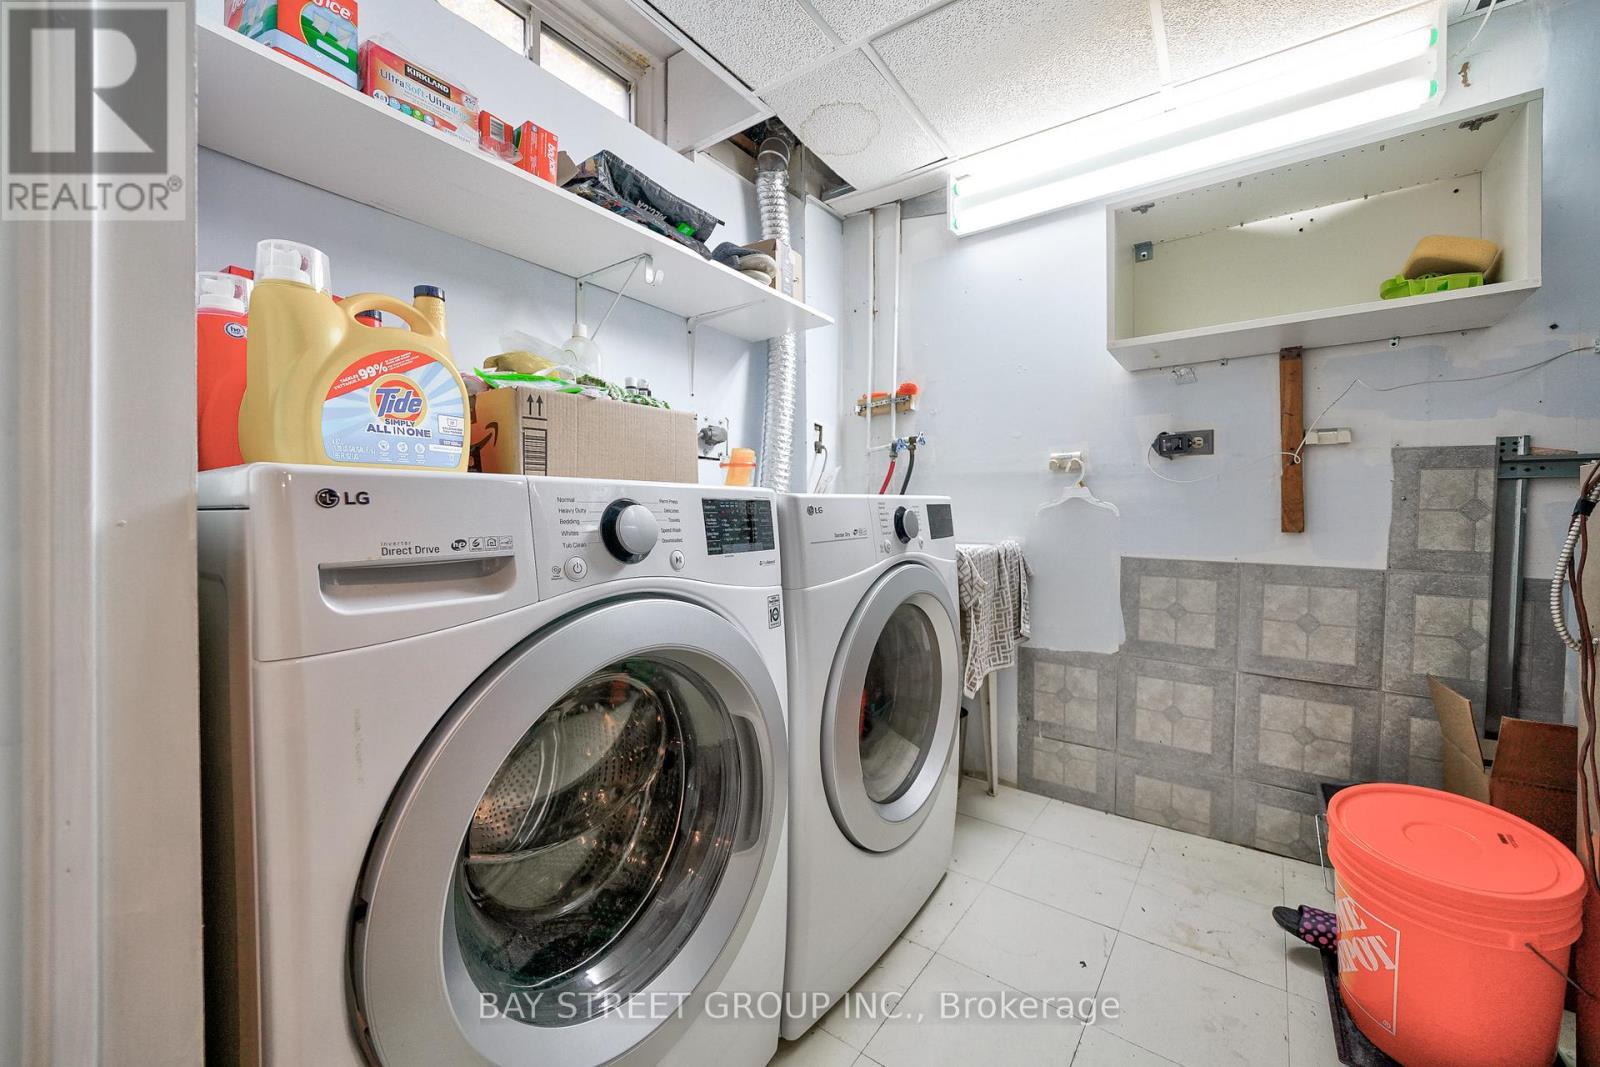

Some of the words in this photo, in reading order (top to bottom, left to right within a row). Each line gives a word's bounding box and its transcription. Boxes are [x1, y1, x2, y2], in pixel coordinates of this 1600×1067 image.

[406, 66, 449, 93] KIRKLAND
[357, 362, 388, 380] 99%
[375, 388, 423, 417] Tide
[385, 418, 416, 427] SIMPLY
[367, 423, 392, 434] ALL
[393, 426, 406, 435] IN
[406, 427, 431, 438] ONE
[344, 491, 370, 505] LG
[814, 506, 823, 514] LG
[381, 546, 413, 556] Direct
[415, 545, 440, 555] Drive
